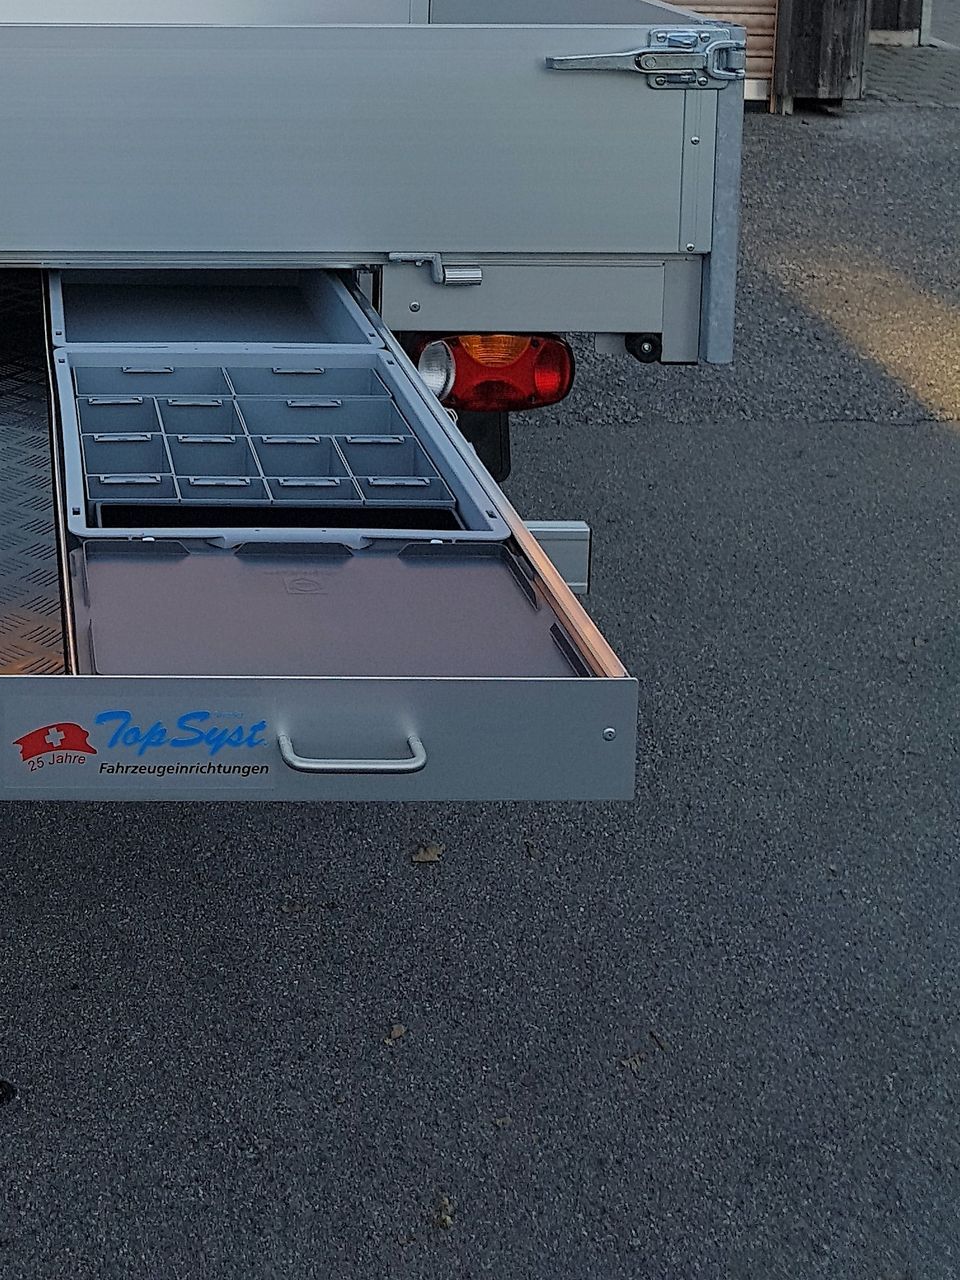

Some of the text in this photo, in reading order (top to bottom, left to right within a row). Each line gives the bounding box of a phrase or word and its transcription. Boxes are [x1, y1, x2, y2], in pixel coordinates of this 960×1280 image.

[26, 752, 87, 772] 25 Jahre
[98, 762, 270, 778] Fahrzeugeinrichtungen
